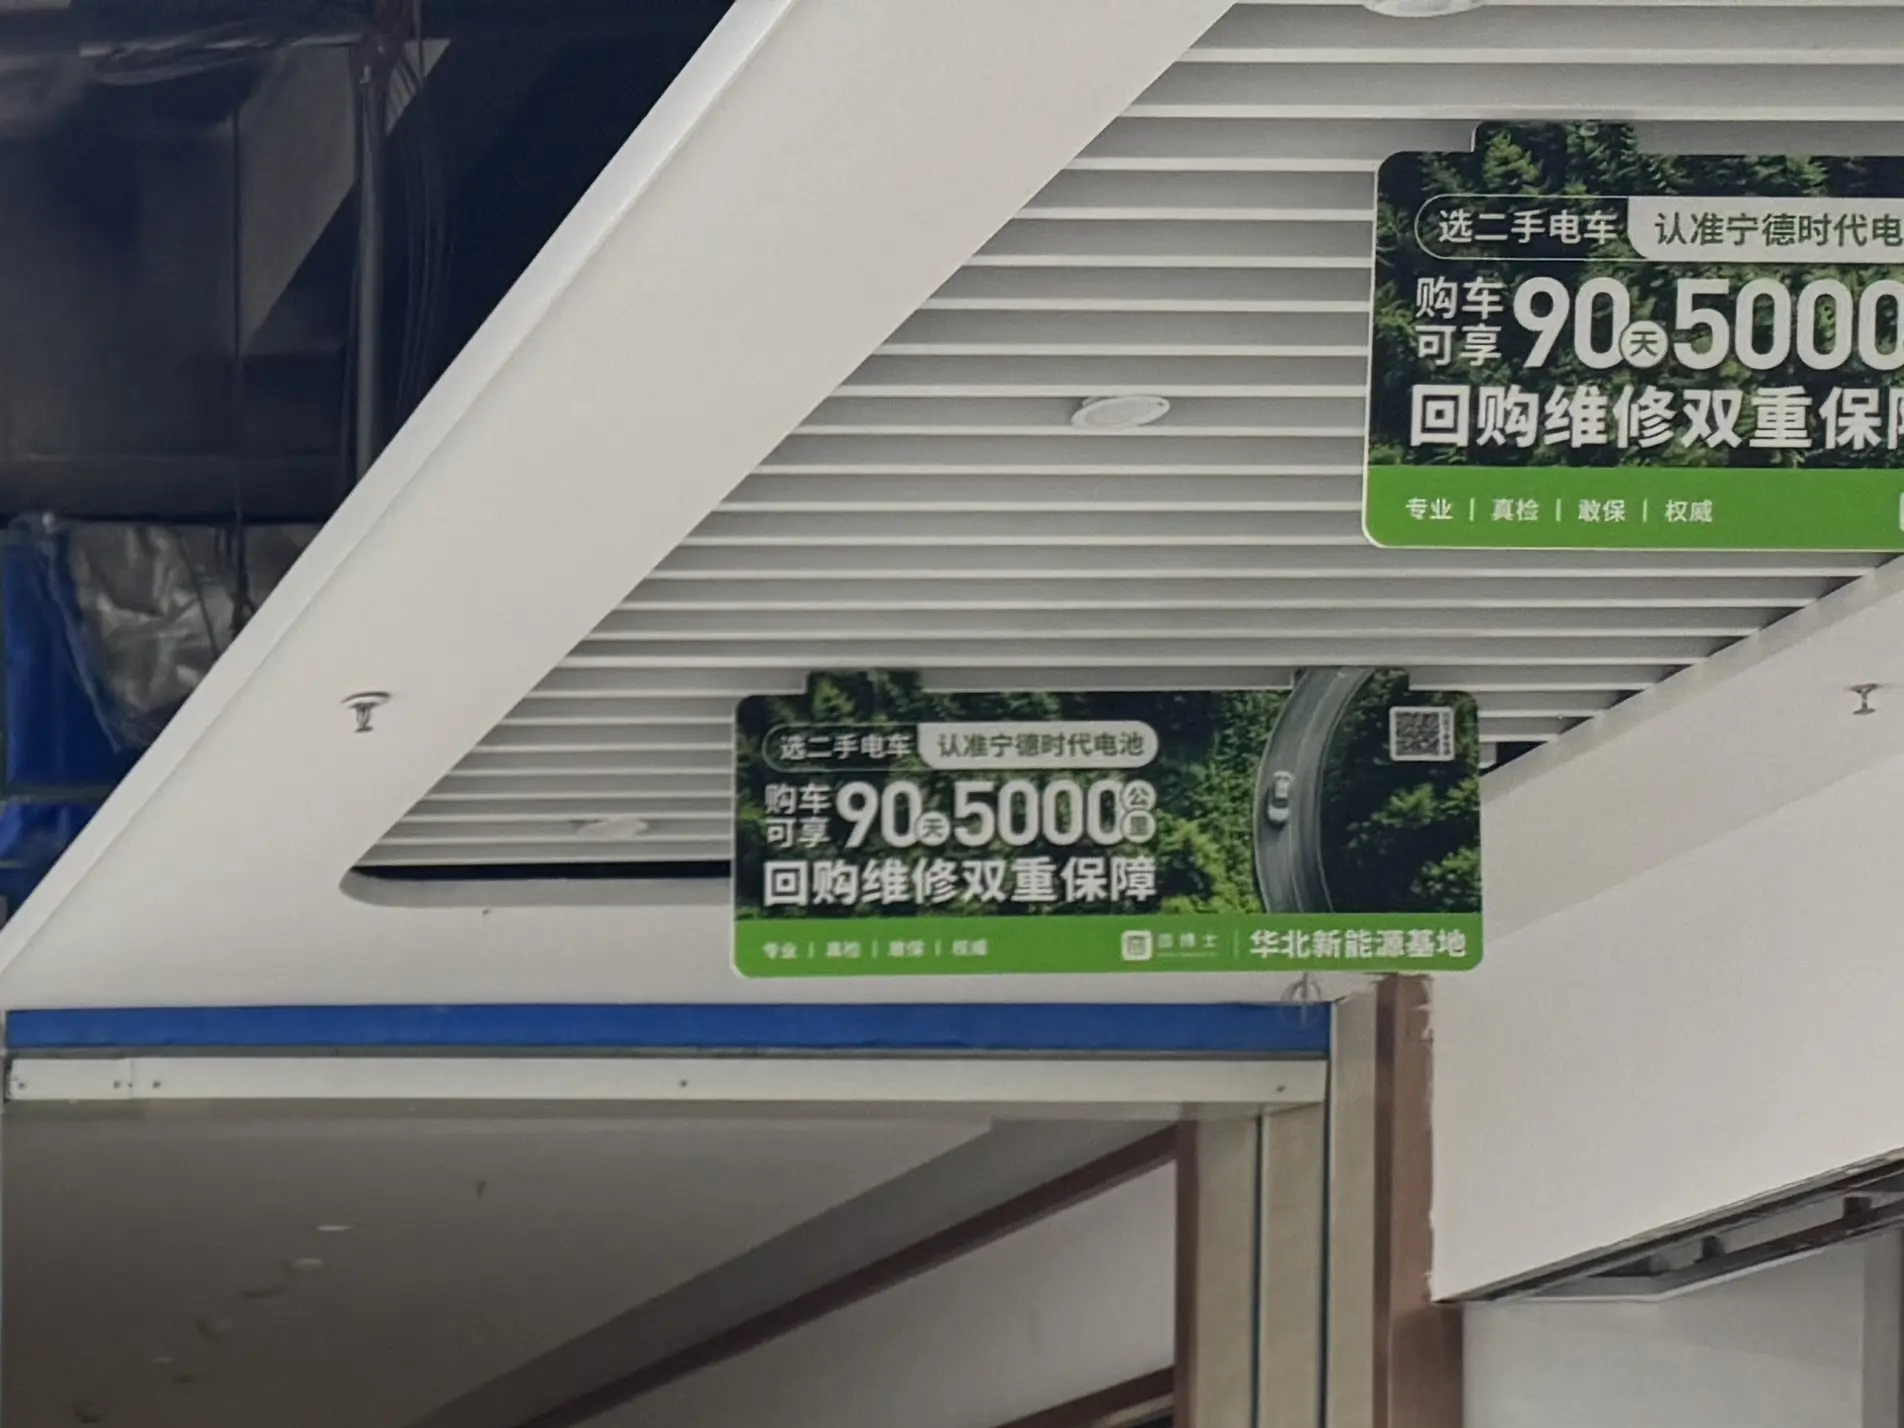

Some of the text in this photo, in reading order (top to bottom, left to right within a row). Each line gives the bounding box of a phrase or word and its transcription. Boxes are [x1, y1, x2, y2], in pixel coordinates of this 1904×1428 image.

[1438, 209, 1618, 245] 选二手电车
[1415, 276, 1503, 321] 购车
[1415, 323, 1502, 366] 可享
[1405, 498, 1454, 521] 专业
[1491, 498, 1539, 522] 真检
[1664, 499, 1713, 523] 权威
[779, 731, 1145, 760] 选二手电车 认准宁德时代电池
[764, 783, 831, 815] 购车
[765, 817, 831, 849] 可享
[763, 856, 1156, 906] 回购维修双重保障
[1249, 928, 1468, 960] 华北新能源基地
